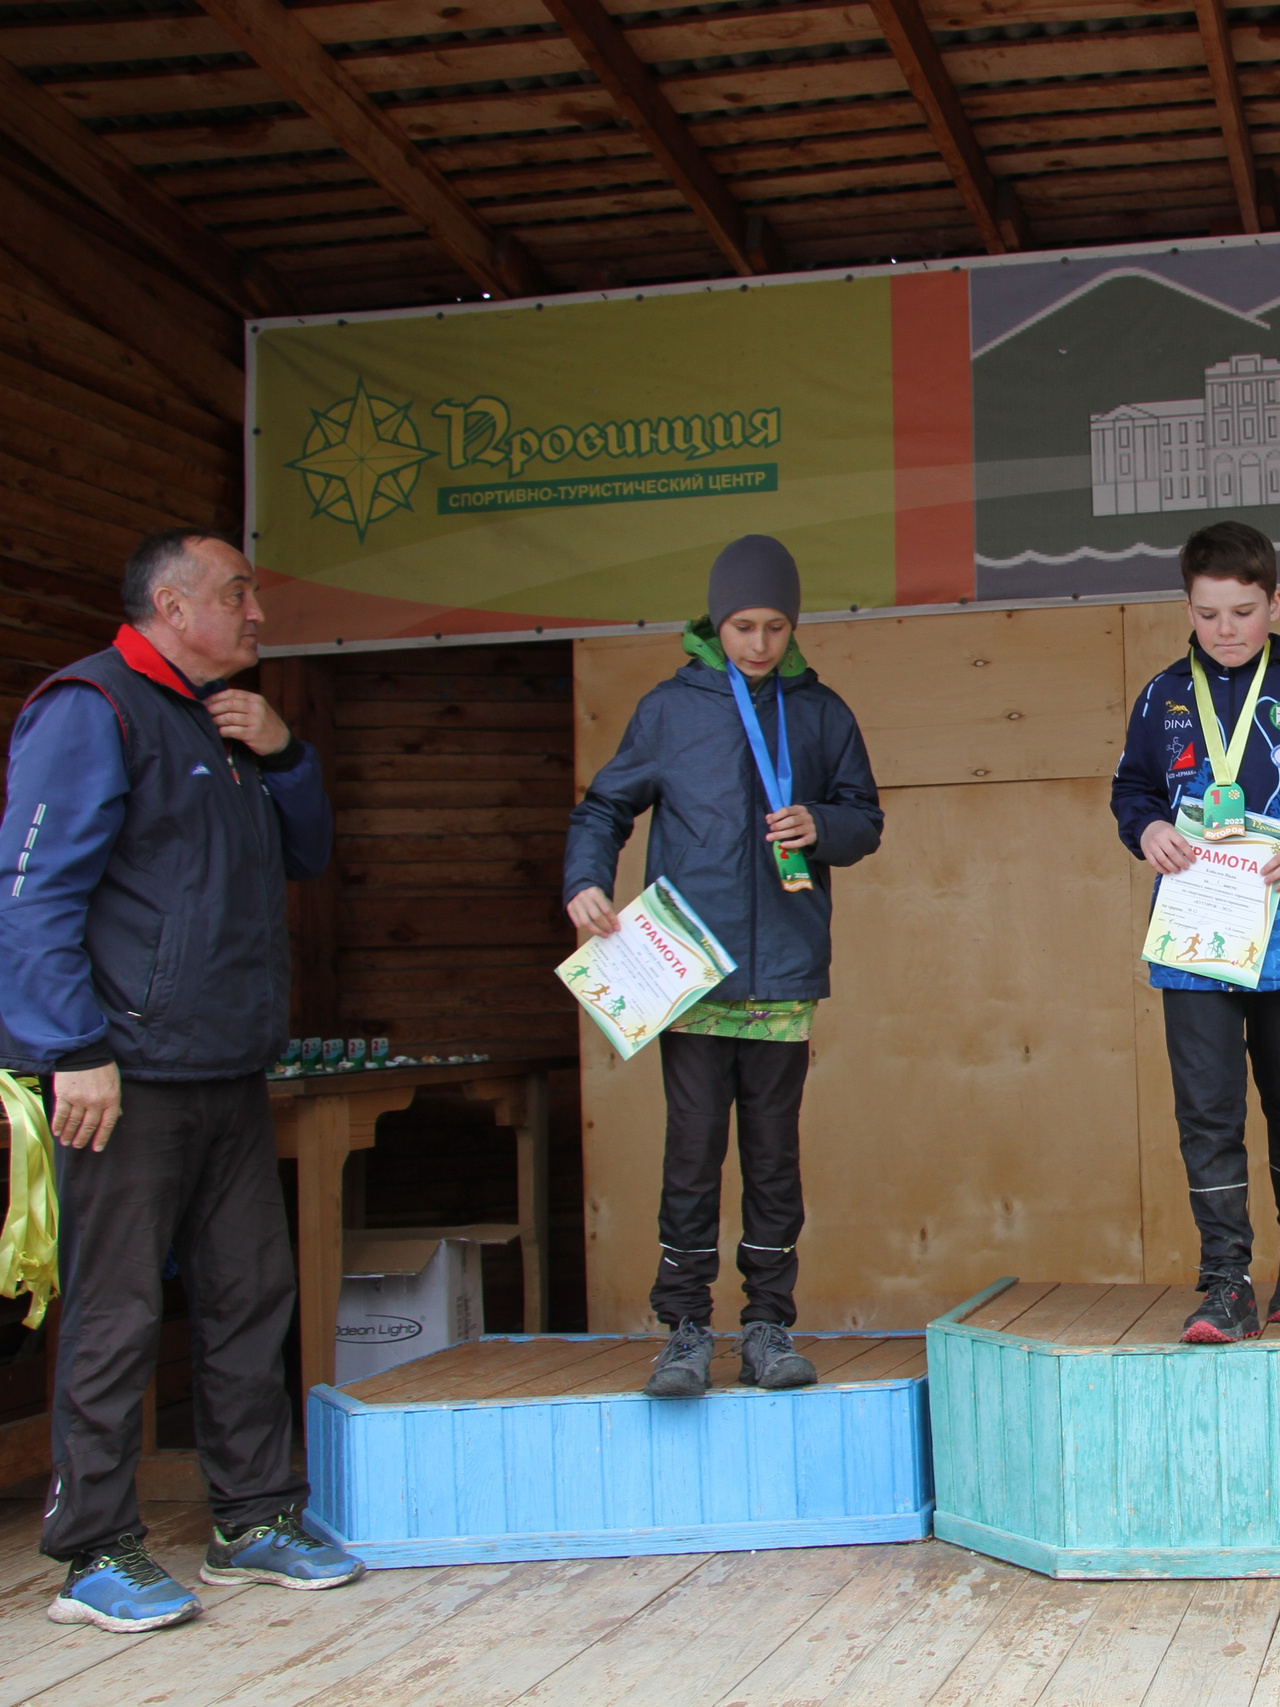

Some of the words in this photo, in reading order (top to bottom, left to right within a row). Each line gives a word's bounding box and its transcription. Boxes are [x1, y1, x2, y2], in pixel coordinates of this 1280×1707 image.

[431, 395, 781, 479] Провинция
[449, 474, 703, 508] СПОРТИВНО-ТУРИСТИЧЕСКИЙ
[708, 471, 766, 491] ЦЕНТР
[1164, 719, 1193, 730] DINA
[1210, 789, 1220, 805] 1
[1224, 817, 1244, 825] 2023
[1205, 826, 1244, 838] БУГОРОК
[1190, 845, 1259, 874] РАМОТА
[634, 914, 688, 979] ГРАМОТА
[378, 1323, 416, 1336] Light
